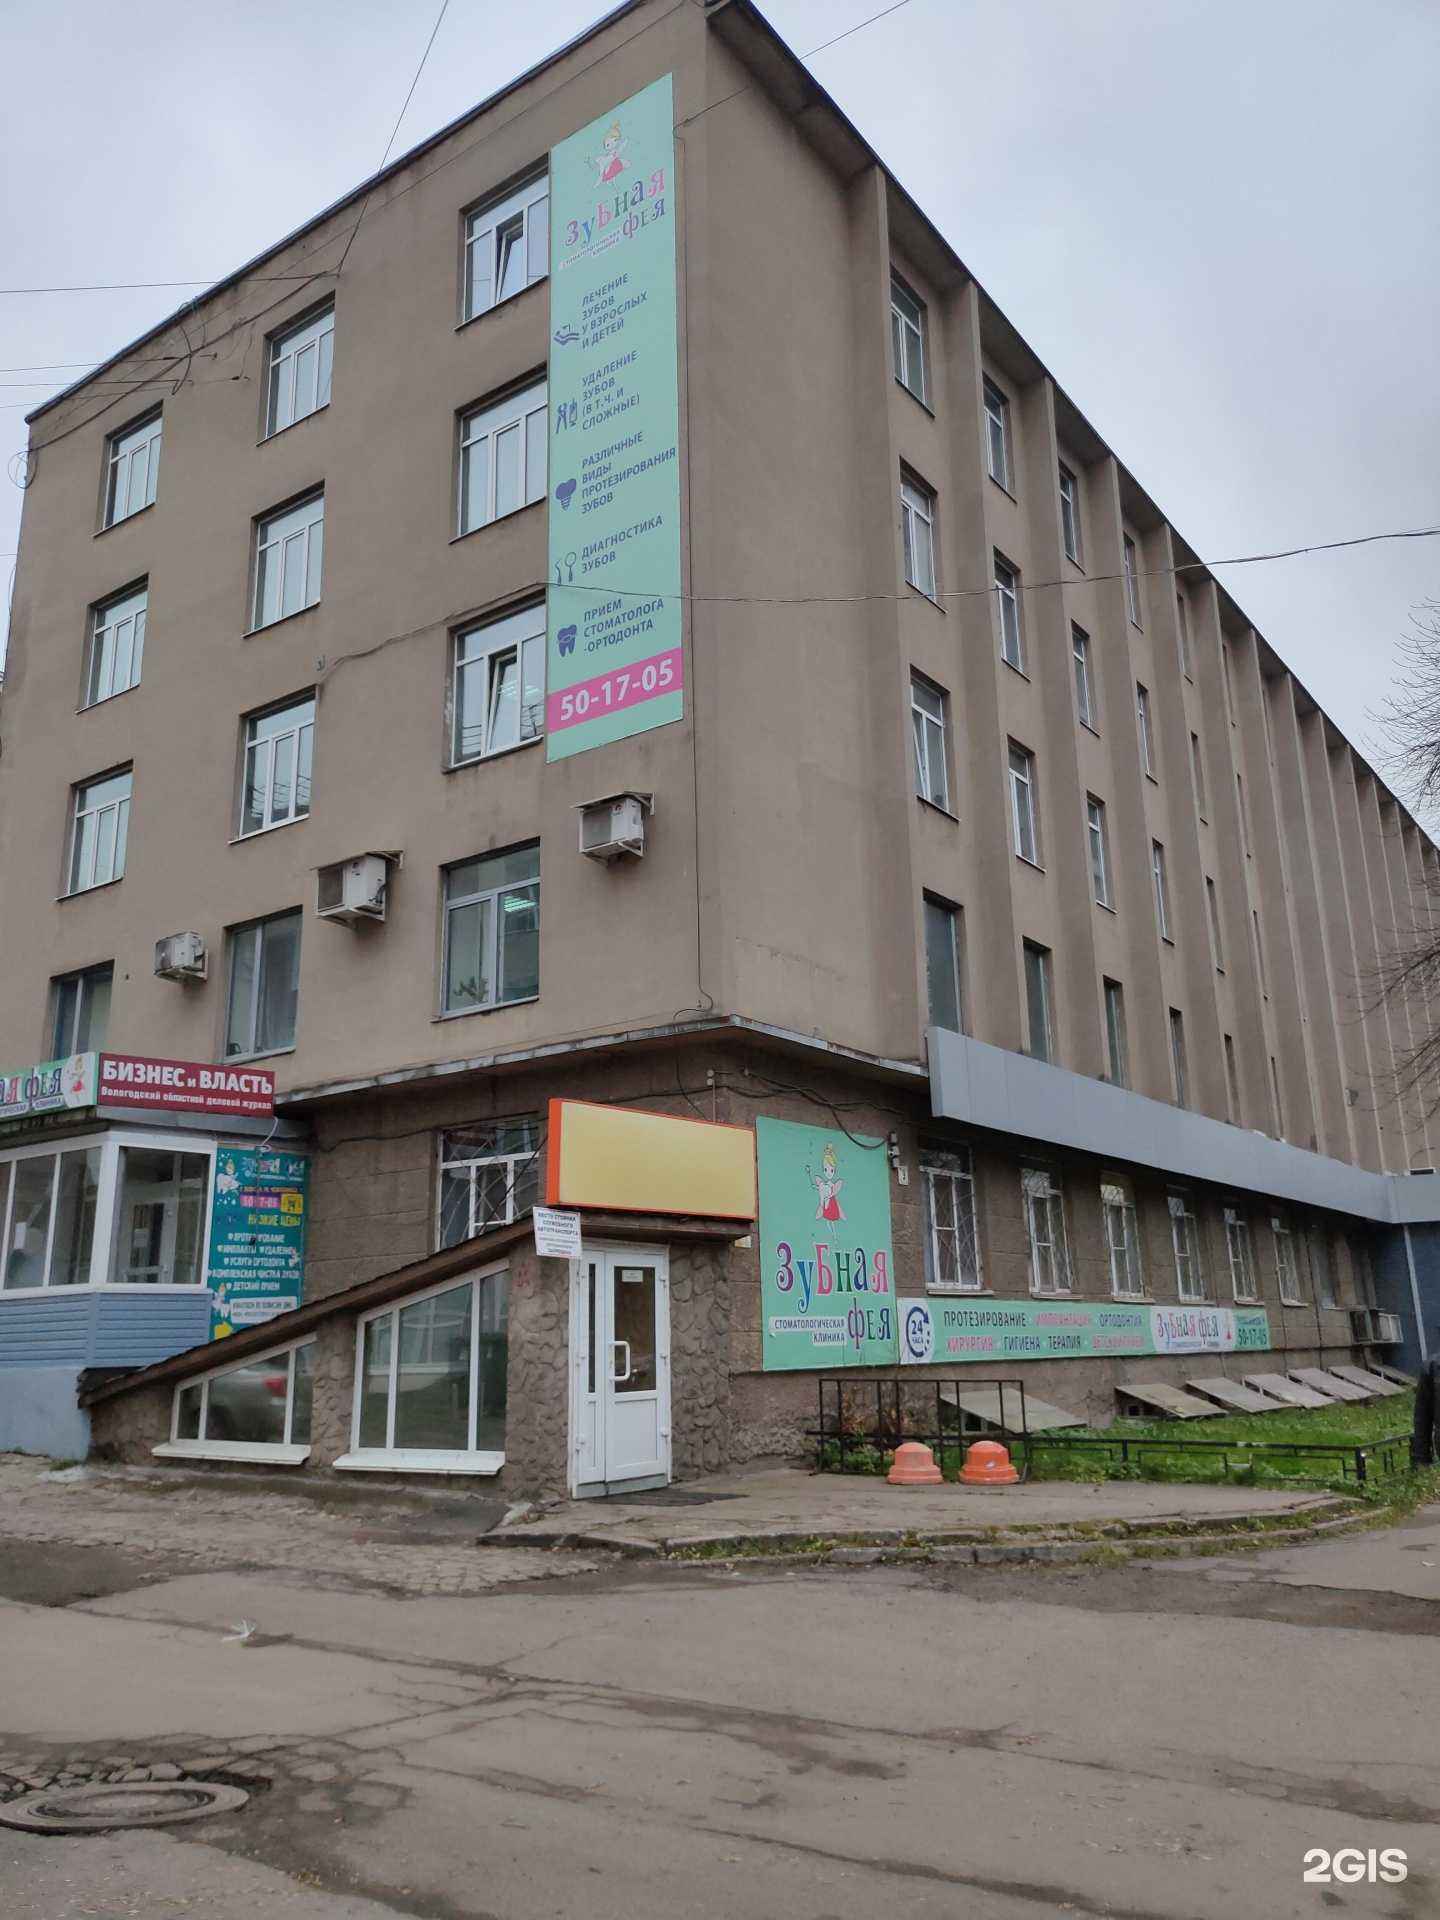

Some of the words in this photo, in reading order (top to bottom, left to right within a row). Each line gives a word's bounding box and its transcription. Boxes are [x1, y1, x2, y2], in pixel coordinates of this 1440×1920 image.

[582, 273, 629, 306] ЛЕЧЕНИЕ
[582, 295, 615, 320] ЗУБОВ
[582, 325, 589, 335] У
[590, 291, 648, 330] ВЗРОСЛЫХ
[582, 339, 589, 349] И
[591, 318, 625, 347] ДЕТЕЙ
[582, 350, 639, 387] УДАЛЕНИЕ
[582, 376, 616, 402] ЗУБОВ
[616, 387, 624, 399] И
[582, 394, 640, 431] СЛОЖНЫЕ)
[582, 432, 644, 469] РАЗЛИЧНЫЕ
[582, 462, 612, 484] ВИДЫ
[582, 447, 676, 499] ПРОТЕЗИРОВАНИЯ
[581, 491, 614, 514] ЗУБОВ
[581, 515, 663, 561] ДИАГНОСТИКА
[581, 551, 617, 574] ЗУБОВ
[583, 598, 664, 638] СТОМАТОЛОГА
[584, 599, 622, 622] ПРИЕМ
[583, 619, 654, 653] -ОРТОДОНТА
[560, 658, 673, 721] 50-17-05
[103, 1059, 184, 1087] БИЗНЕС
[187, 1078, 197, 1088] и
[199, 1070, 273, 1094] ВЛАСТЬ
[101, 1086, 161, 1100] Вологодский
[162, 1091, 205, 1104] областной
[206, 1096, 240, 1107] деловой
[241, 1100, 272, 1110] журнал
[774, 1318, 845, 1330] СТОМАТОЛОГИЧЕСКАЯ
[911, 1319, 924, 1335] 24
[944, 1310, 1026, 1328] ПРОТЕЗИРОВАНИЕ
[1099, 1312, 1142, 1327] ОРТОДОНТИЯ
[813, 1332, 845, 1343] КЛИНИКА
[911, 1337, 924, 1345] ЧАСА
[947, 1336, 993, 1352] ХИРУРГИЯ
[1003, 1335, 1041, 1351] ГИГИЕНА
[1048, 1335, 1081, 1350] ТЕРАПИЯ
[1238, 1328, 1268, 1345] 50-17-05
